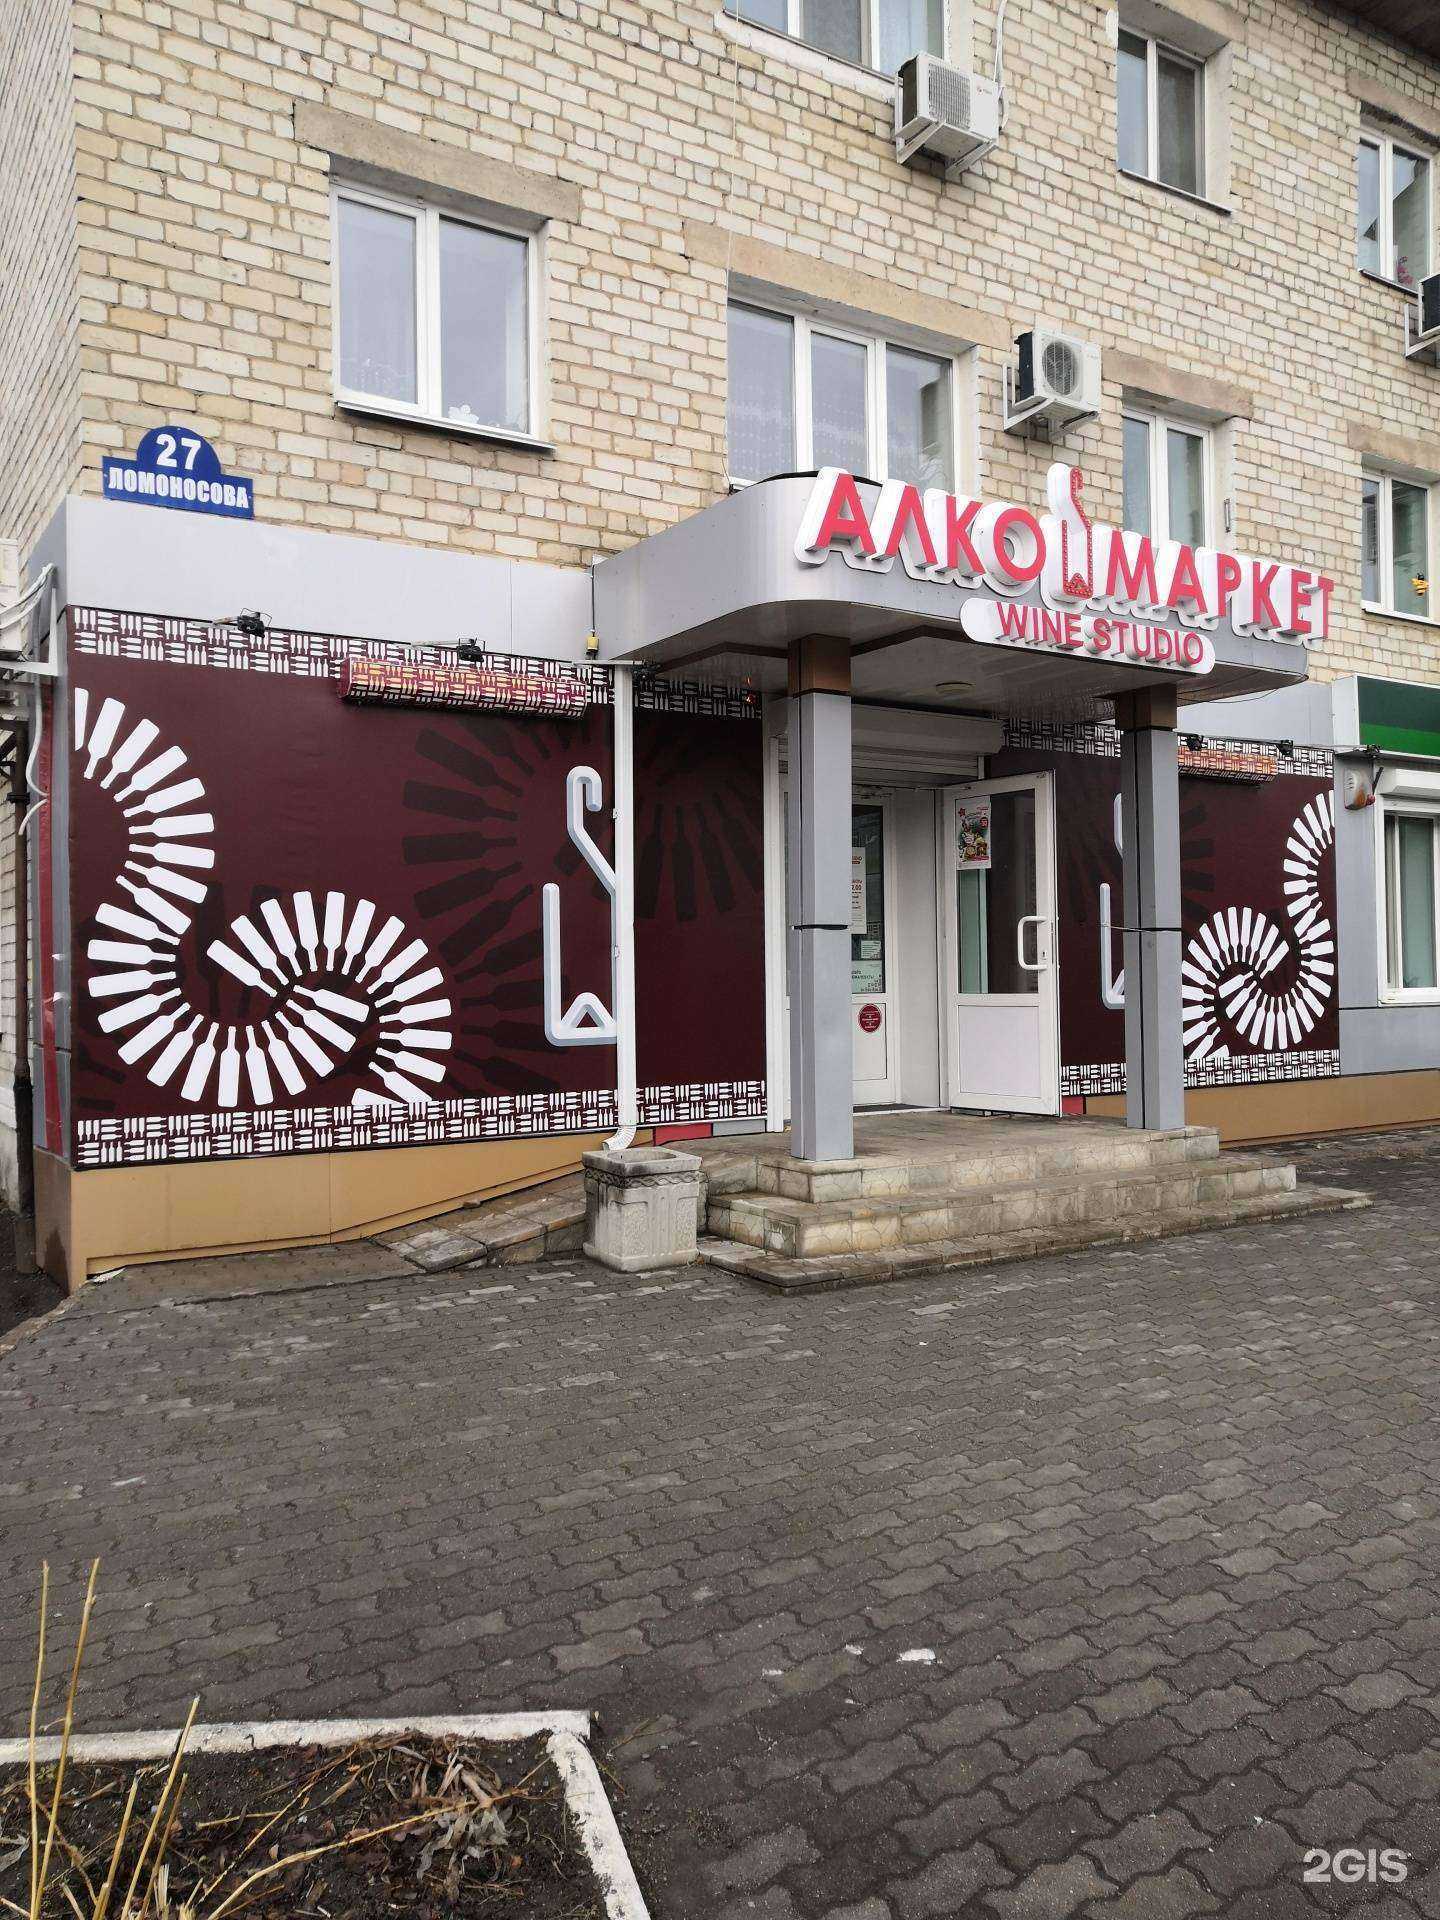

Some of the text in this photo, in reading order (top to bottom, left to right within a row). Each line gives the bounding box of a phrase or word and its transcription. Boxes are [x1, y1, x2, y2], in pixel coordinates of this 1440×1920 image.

[156, 433, 202, 471] 27
[108, 466, 250, 509] ЛОМОНОСОВА
[806, 471, 1335, 640] АЛКО МАРКЕТ
[997, 602, 1204, 666] WINE STUDIO
